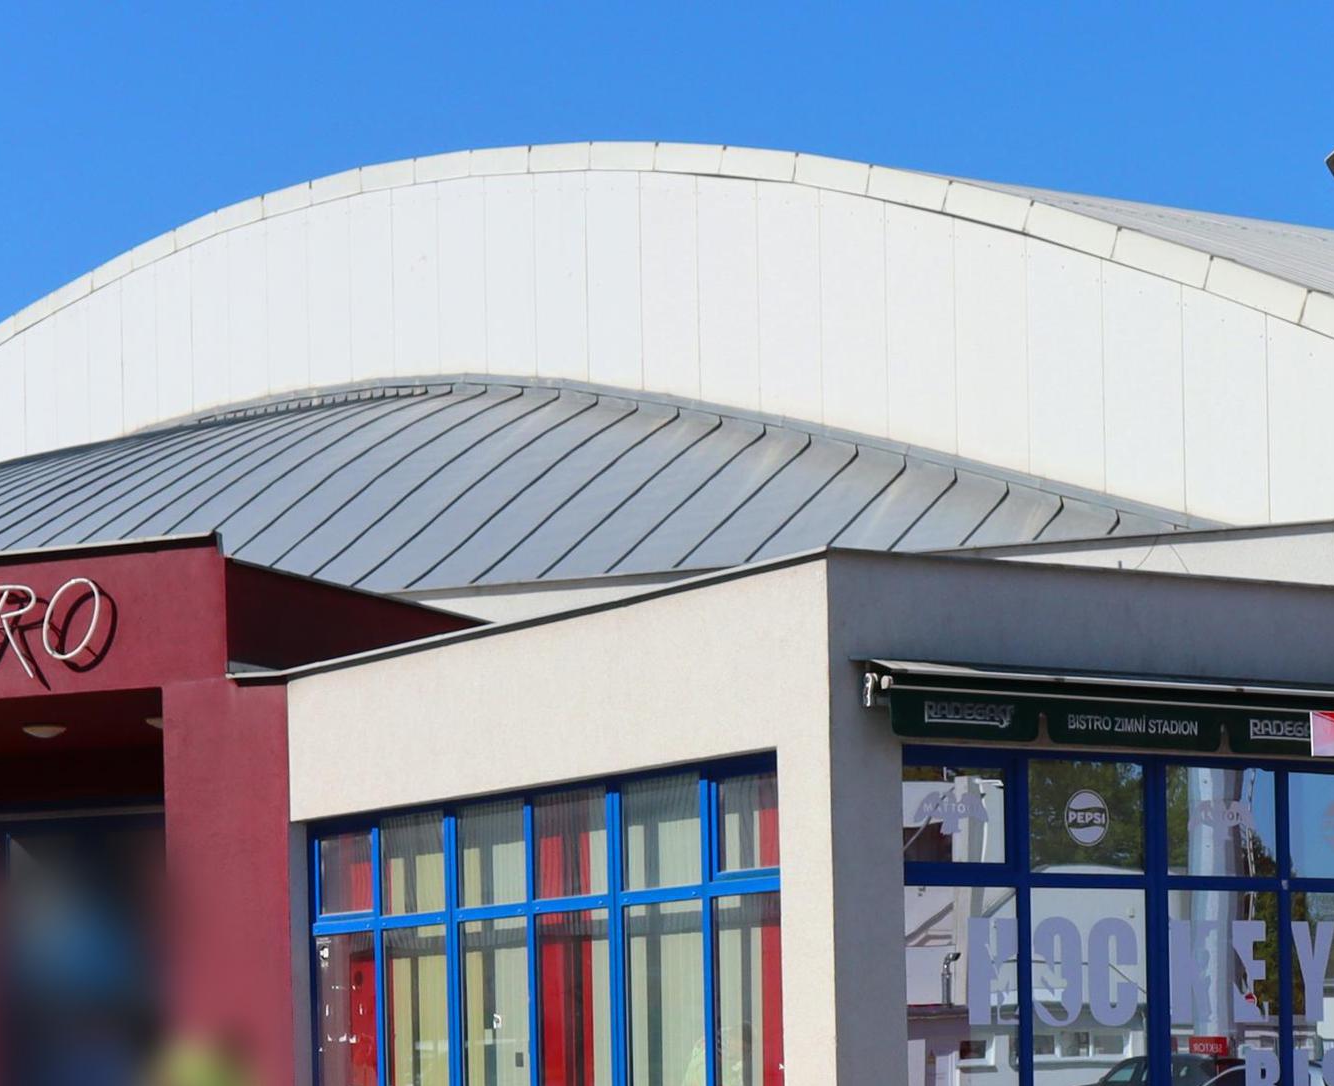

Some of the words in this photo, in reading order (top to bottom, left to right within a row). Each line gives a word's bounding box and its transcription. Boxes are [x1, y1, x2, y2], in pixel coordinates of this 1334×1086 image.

[925, 701, 1014, 728] RADEGAST
[1067, 714, 1111, 731] BISTRO
[1114, 716, 1145, 733] ZIMNÍ
[1147, 719, 1198, 736] STADION
[1067, 809, 1106, 826] PEPSI
[968, 916, 1334, 1028] HOCKEY
